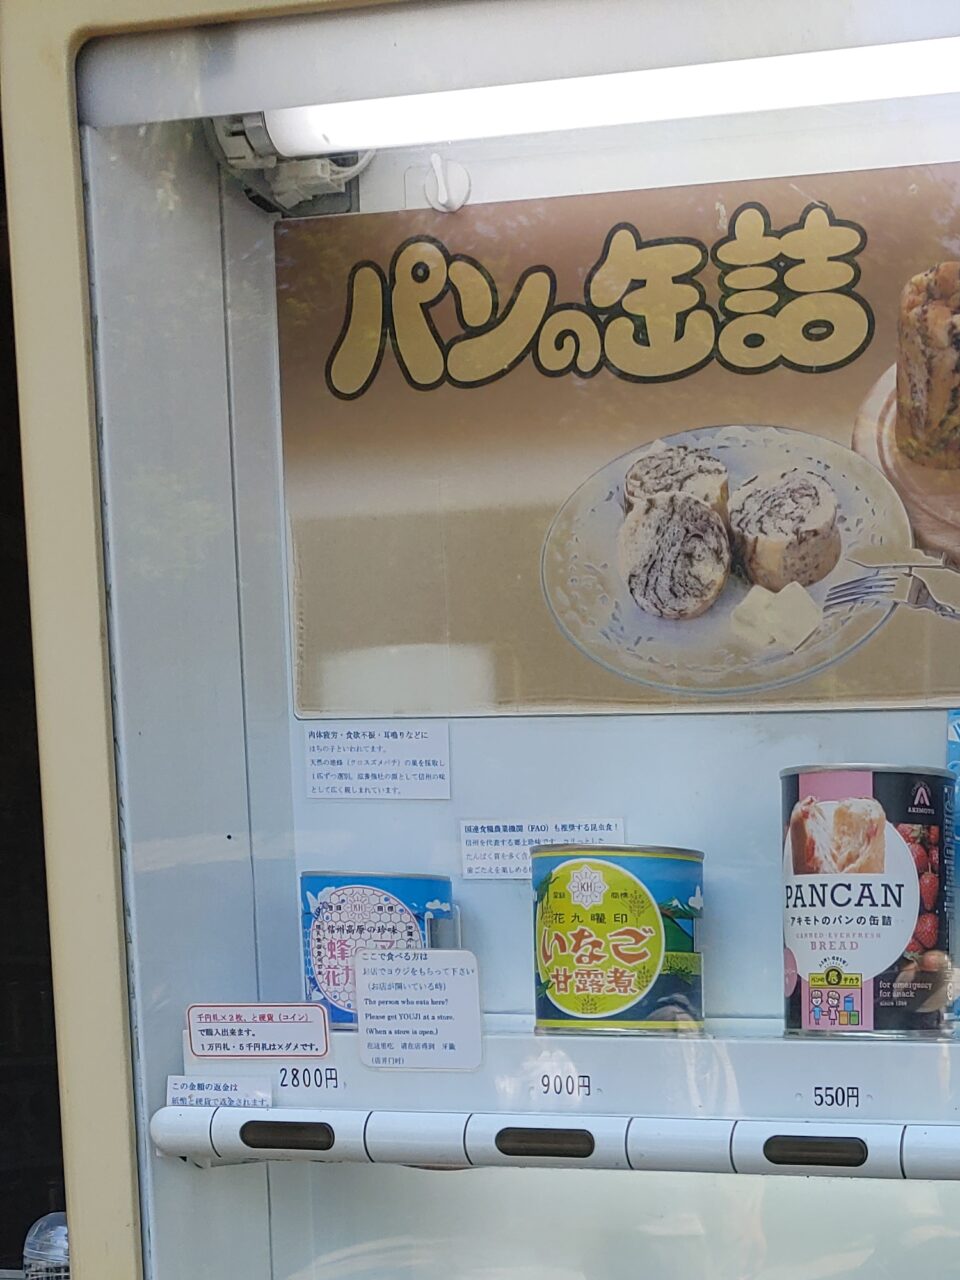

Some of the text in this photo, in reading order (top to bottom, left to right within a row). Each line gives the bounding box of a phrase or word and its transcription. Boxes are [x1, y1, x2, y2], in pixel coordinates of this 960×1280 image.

[325, 201, 875, 400] パンの缶詰
[785, 882, 905, 908] PANCAN
[790, 915, 893, 926] アキモトのパンの缶詰
[541, 926, 655, 966] いなご
[810, 941, 859, 950] BREAD
[361, 953, 428, 961] ここで食べる方は
[551, 966, 639, 994] 甘露煮
[279, 1067, 339, 1089] 2800円
[541, 1074, 591, 1097] 900円
[814, 1086, 860, 1108] 550円
